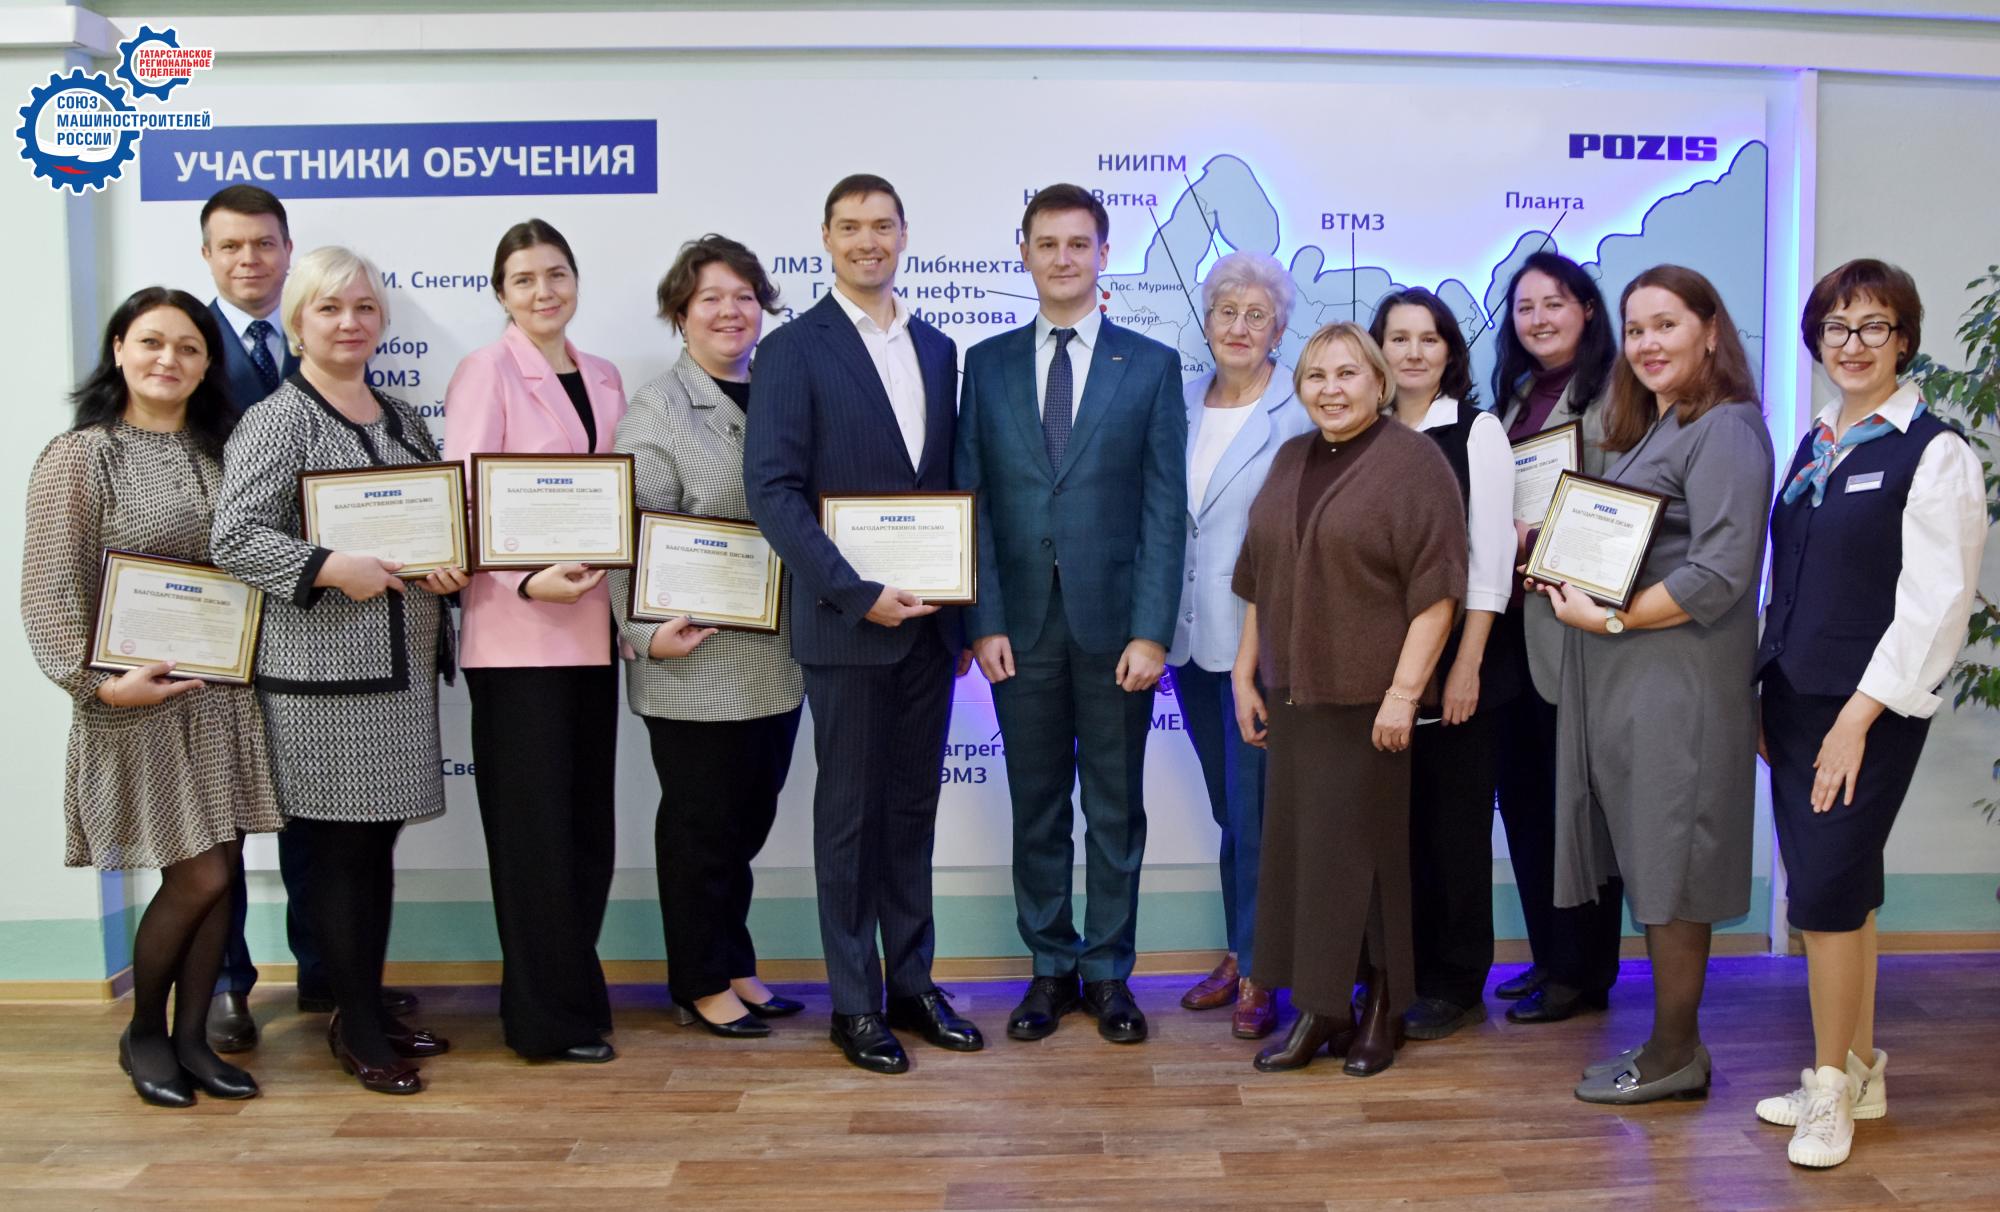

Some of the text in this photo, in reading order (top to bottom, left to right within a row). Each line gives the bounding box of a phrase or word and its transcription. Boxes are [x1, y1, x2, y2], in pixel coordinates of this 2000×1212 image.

[1568, 133, 1718, 162] POZIS
[174, 144, 636, 183] УЧАСТНИКИ ОБУЧЕНИЯ
[1098, 153, 1187, 172] НИИПМ
[1091, 188, 1158, 207] Вятка
[1505, 191, 1585, 210] Планта
[1321, 213, 1386, 231] ВТМЗ
[771, 256, 823, 274] ЛМЗ
[903, 255, 1026, 274] Либкнехта
[411, 271, 489, 293] Снегир
[1110, 281, 1184, 293] Пос. Мурино
[916, 281, 986, 303] нефть
[1108, 313, 1161, 326] етербург
[376, 336, 429, 359] ибор
[536, 477, 574, 485] POZIS
[364, 489, 402, 499] POZIS
[1593, 503, 1618, 515] POZIS
[693, 537, 729, 548] POZIS
[165, 582, 203, 594] POZIS
